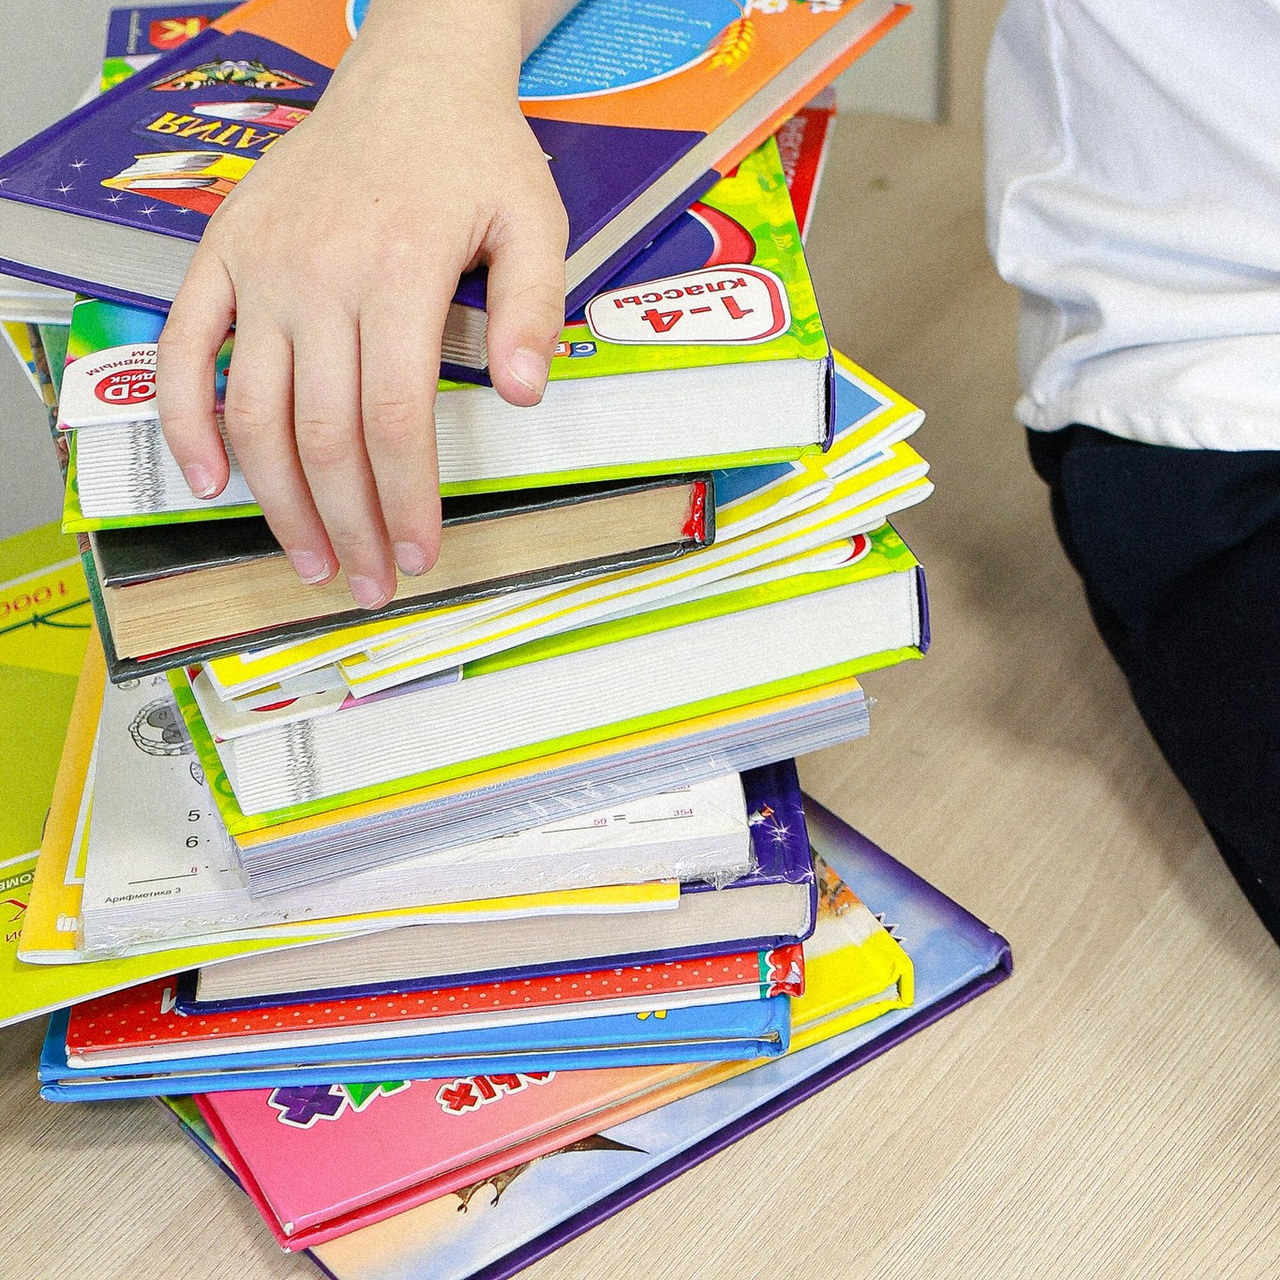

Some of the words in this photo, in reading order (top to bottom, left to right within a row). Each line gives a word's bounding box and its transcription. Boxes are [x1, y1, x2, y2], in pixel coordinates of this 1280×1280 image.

[146, 111, 284, 154] АТИЯ
[613, 278, 748, 309] классы
[188, 810, 200, 822] 5
[185, 836, 199, 848] 6
[105, 889, 171, 904] Арифметика
